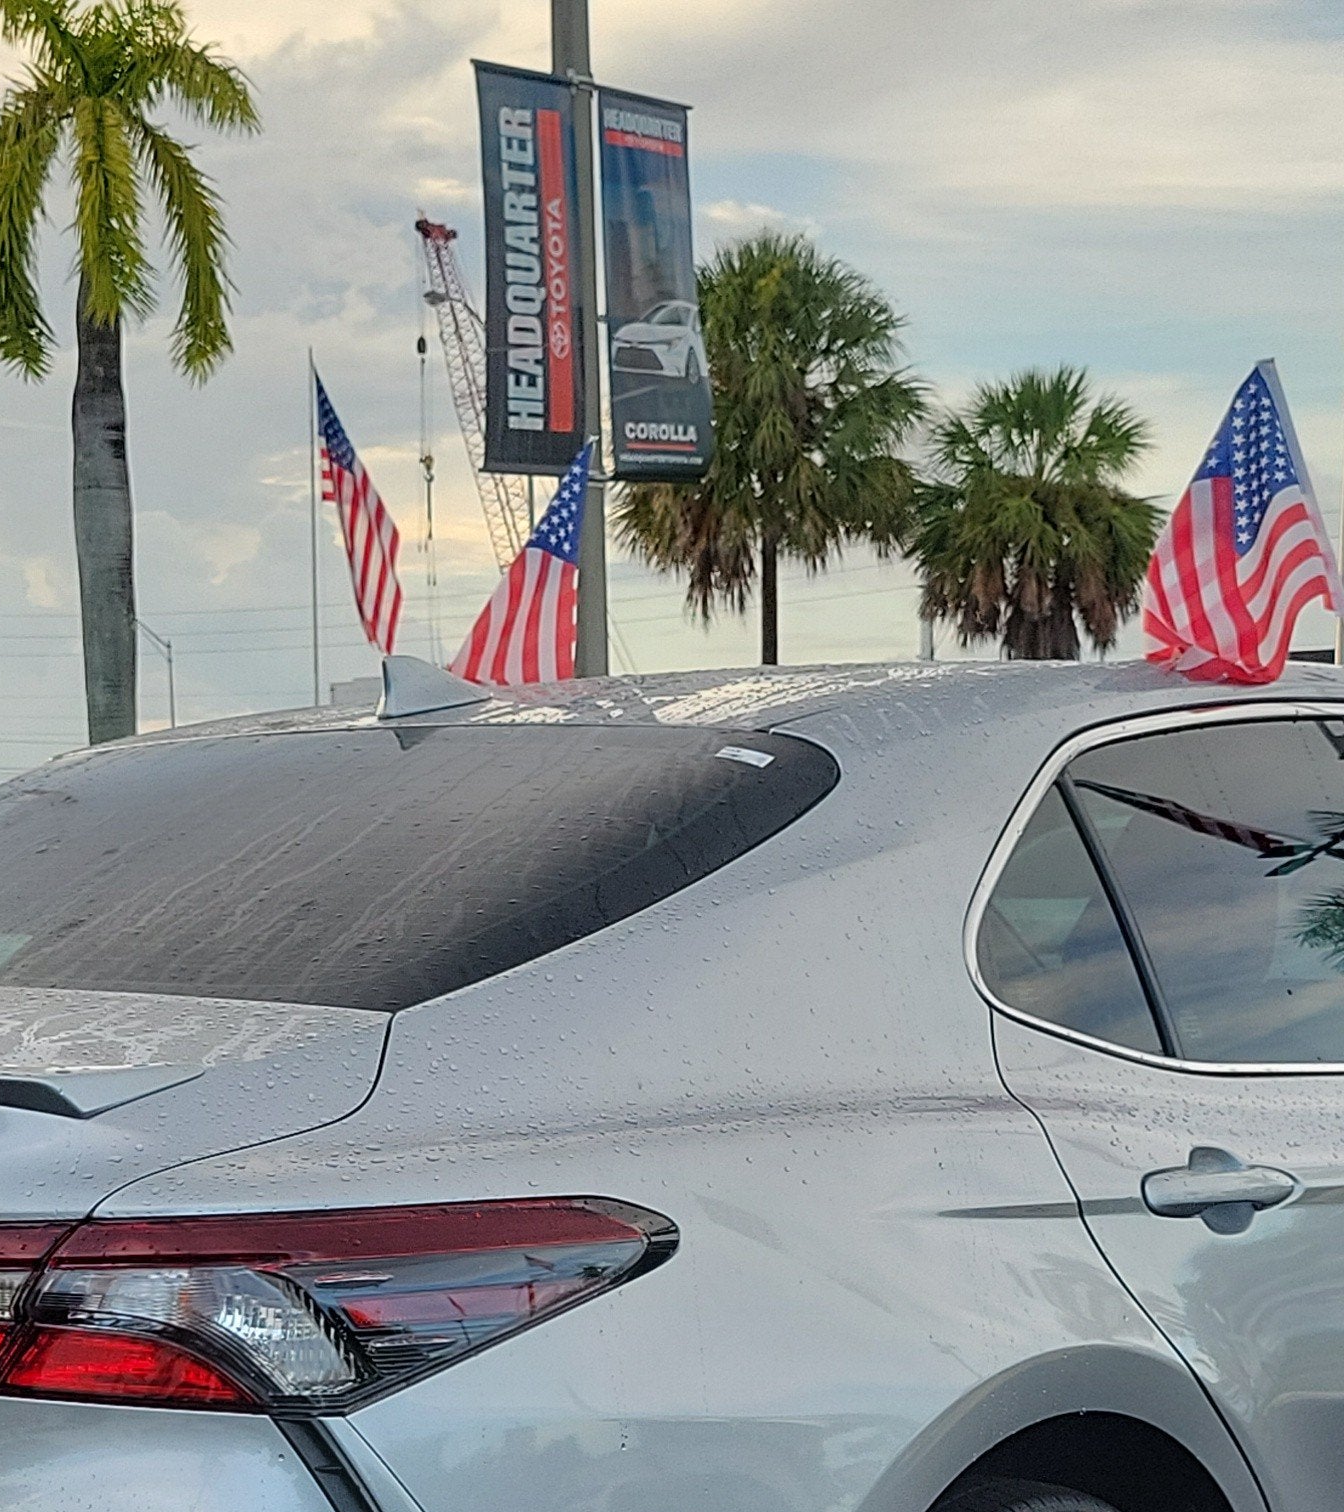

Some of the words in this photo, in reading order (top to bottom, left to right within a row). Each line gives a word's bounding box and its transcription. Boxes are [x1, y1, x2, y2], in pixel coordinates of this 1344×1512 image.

[499, 106, 546, 430] HEADQUARTER
[546, 198, 568, 316] TOYOTA
[624, 421, 698, 442] COROLLA
